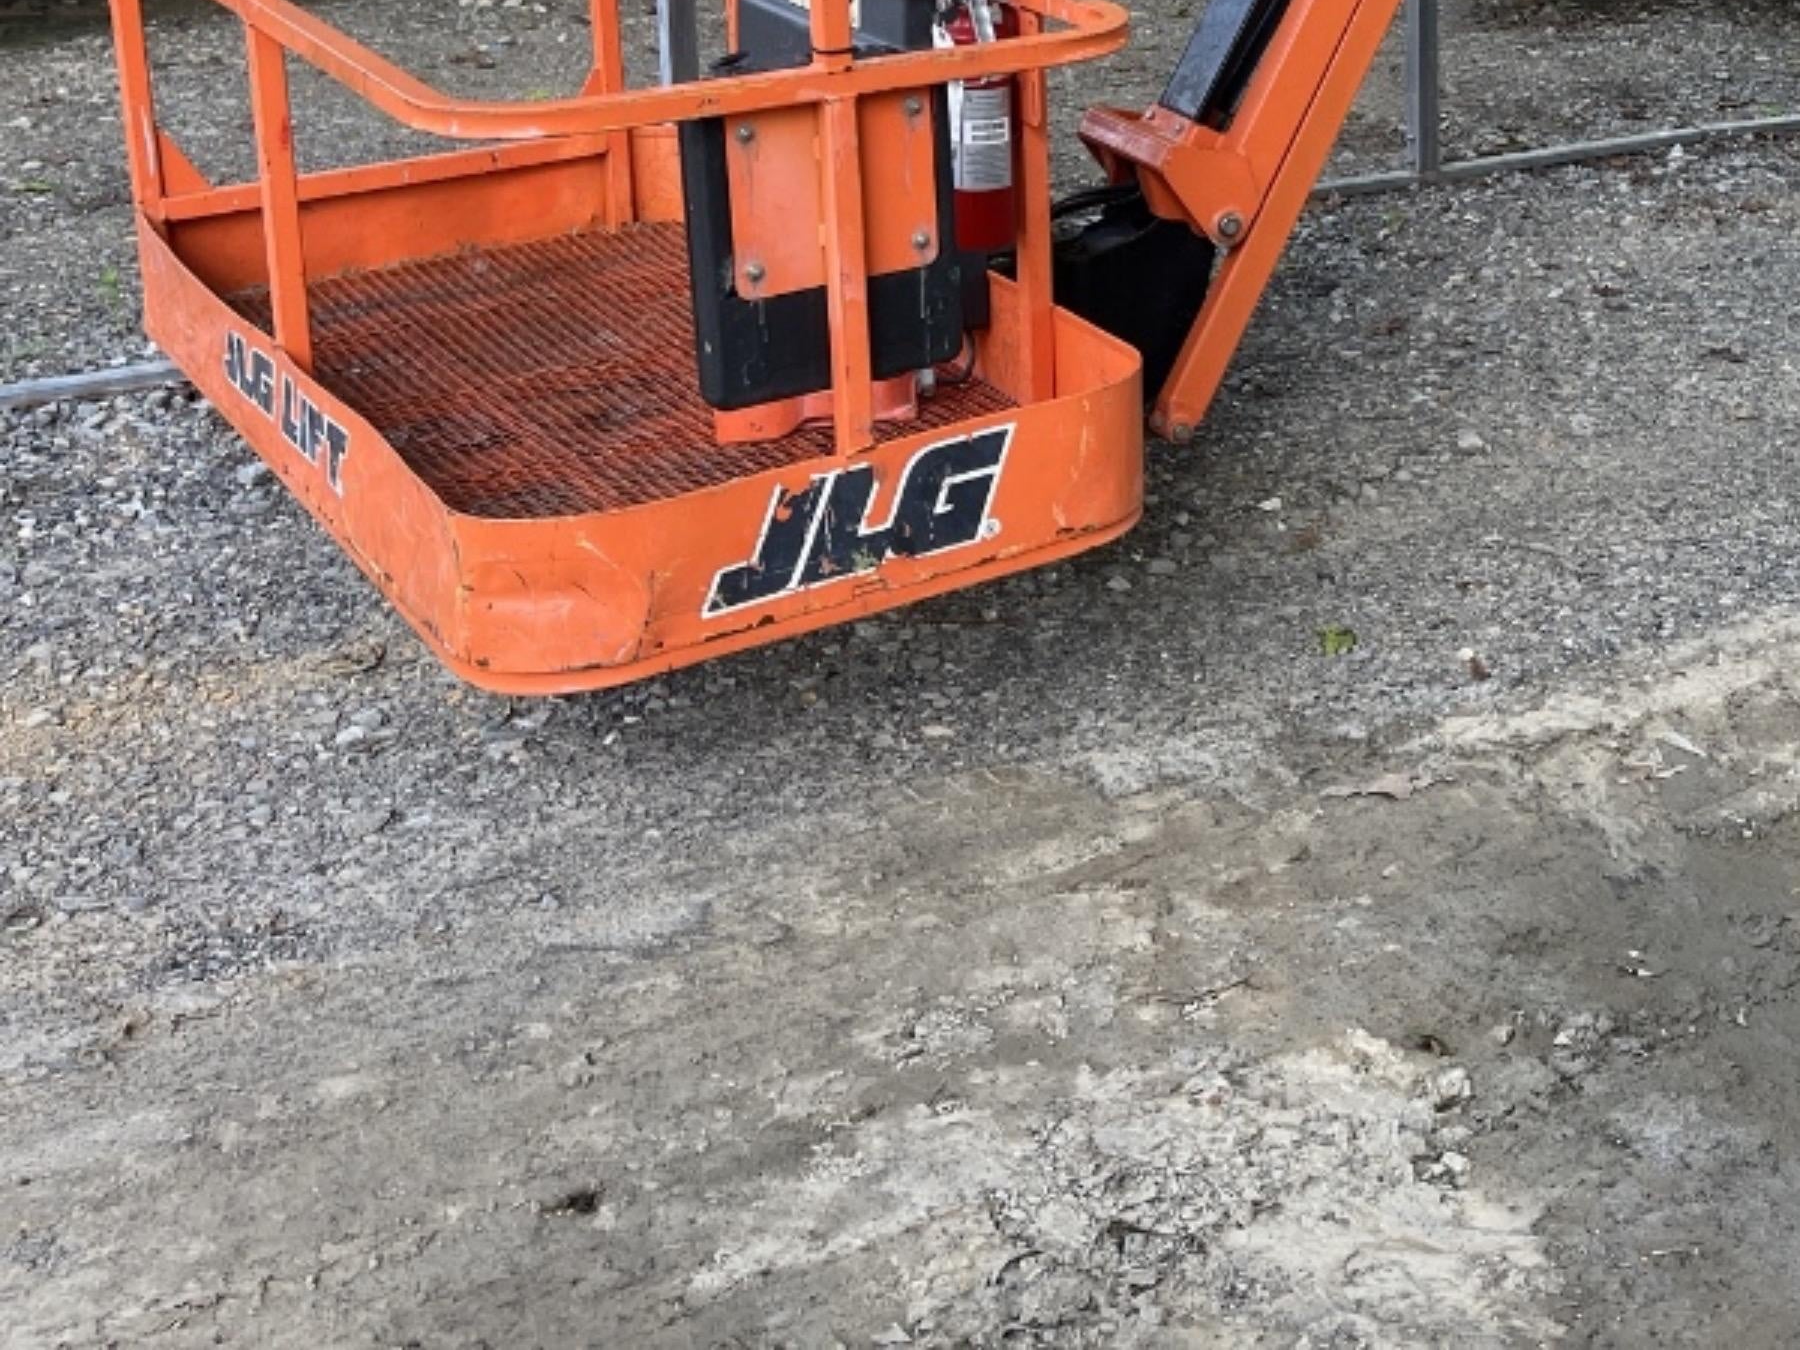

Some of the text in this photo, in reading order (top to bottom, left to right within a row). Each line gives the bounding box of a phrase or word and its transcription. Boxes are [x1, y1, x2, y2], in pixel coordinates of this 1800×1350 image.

[224, 329, 351, 498] JLG LIFT
[702, 422, 1017, 619] JLG
